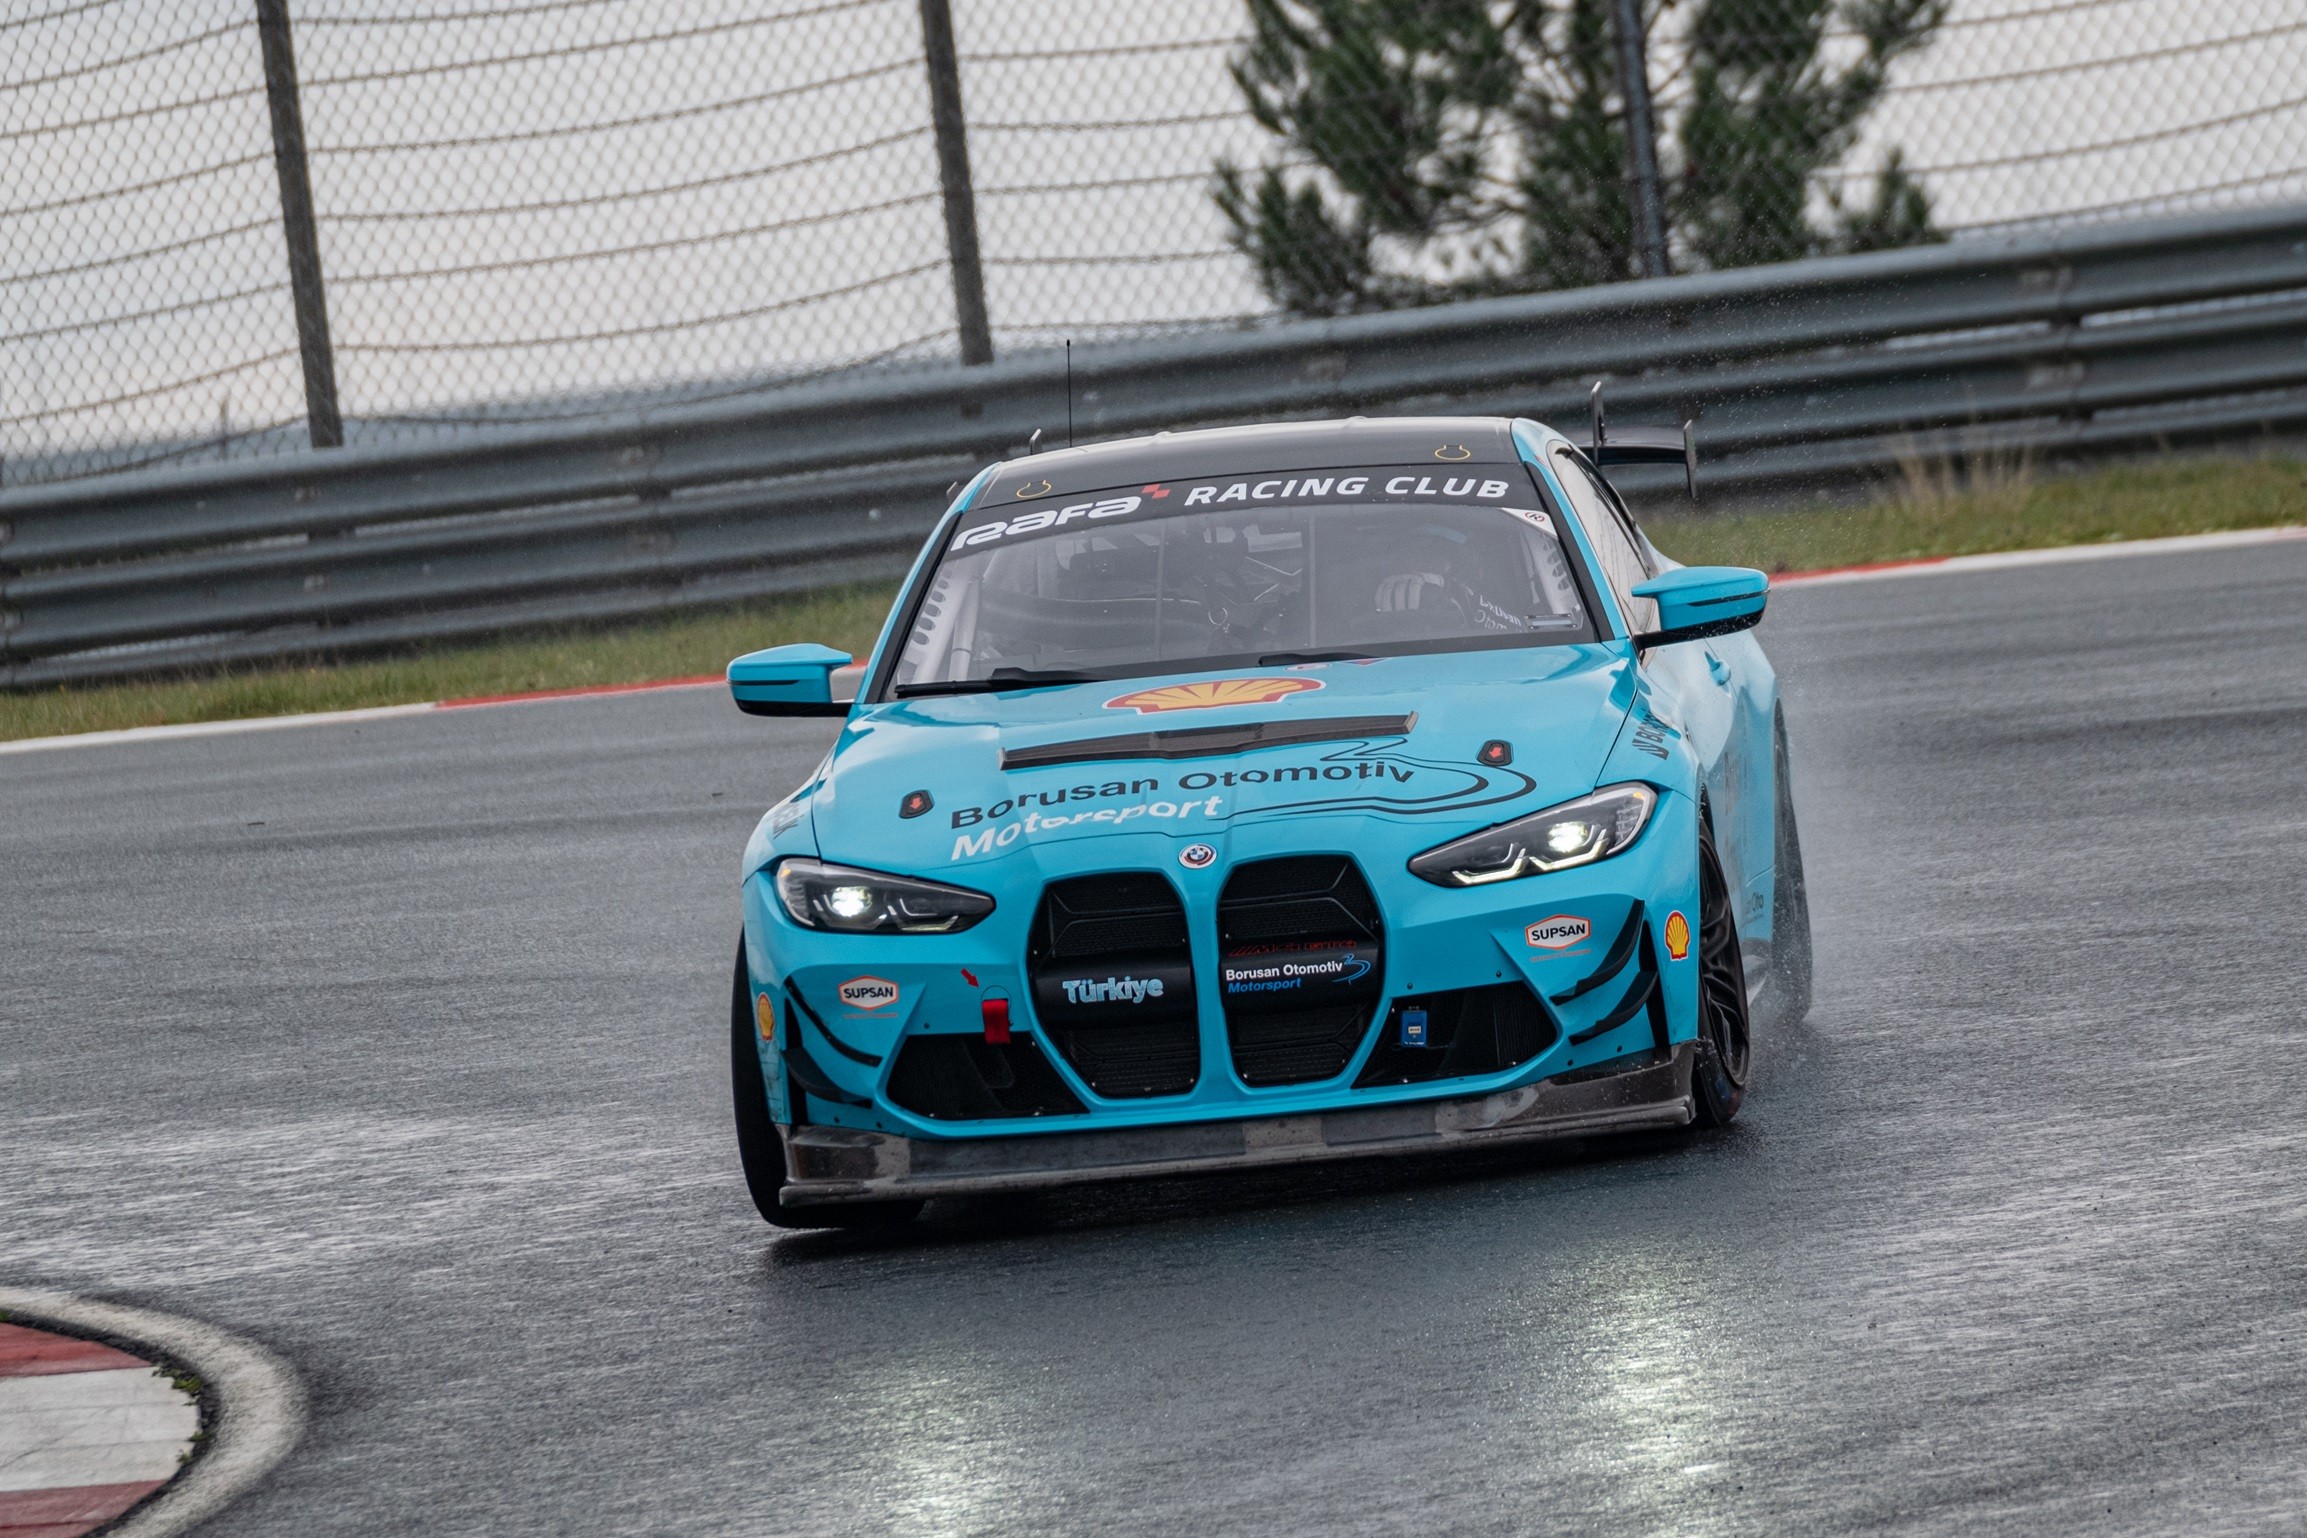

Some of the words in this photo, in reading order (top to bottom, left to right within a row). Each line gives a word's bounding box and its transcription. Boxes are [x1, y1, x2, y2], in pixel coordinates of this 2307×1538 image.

[1184, 476, 1370, 506] RACING
[1385, 476, 1509, 498] CLUB
[951, 776, 1159, 829] Borusan
[1178, 761, 1415, 790] Otomotiv
[951, 795, 1223, 861] Motorsport
[1531, 923, 1586, 941] SUPSAN
[1225, 966, 1280, 981] Borusan
[1283, 961, 1343, 976] Otomotiv
[843, 986, 894, 999] SUPSAN
[1062, 975, 1164, 1004] Türkiye
[1228, 977, 1302, 994] Motorsport
